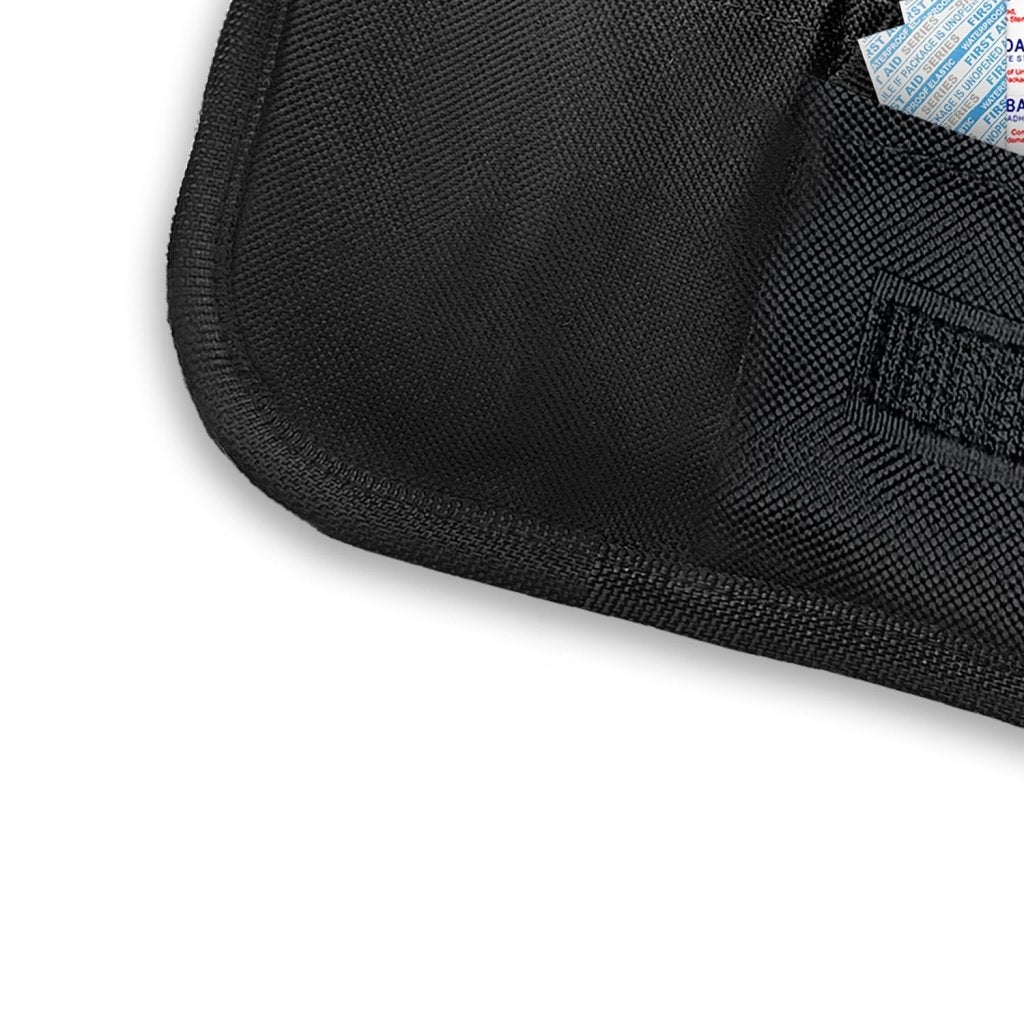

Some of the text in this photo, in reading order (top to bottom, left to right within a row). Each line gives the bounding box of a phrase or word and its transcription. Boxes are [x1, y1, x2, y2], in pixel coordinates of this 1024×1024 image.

[884, 17, 938, 77] AID SERIES
[901, 40, 938, 78] PACKAGE
[934, 30, 946, 40] IS
[905, 34, 960, 96] AID SERIES
[928, 59, 956, 88] ELASTIC
[961, 4, 1006, 50] WATERPROOF
[954, 89, 964, 101] IS
[962, 46, 1003, 90] UNOPENED
[964, 32, 994, 66] FIRST
[921, 74, 958, 115] SERIES
